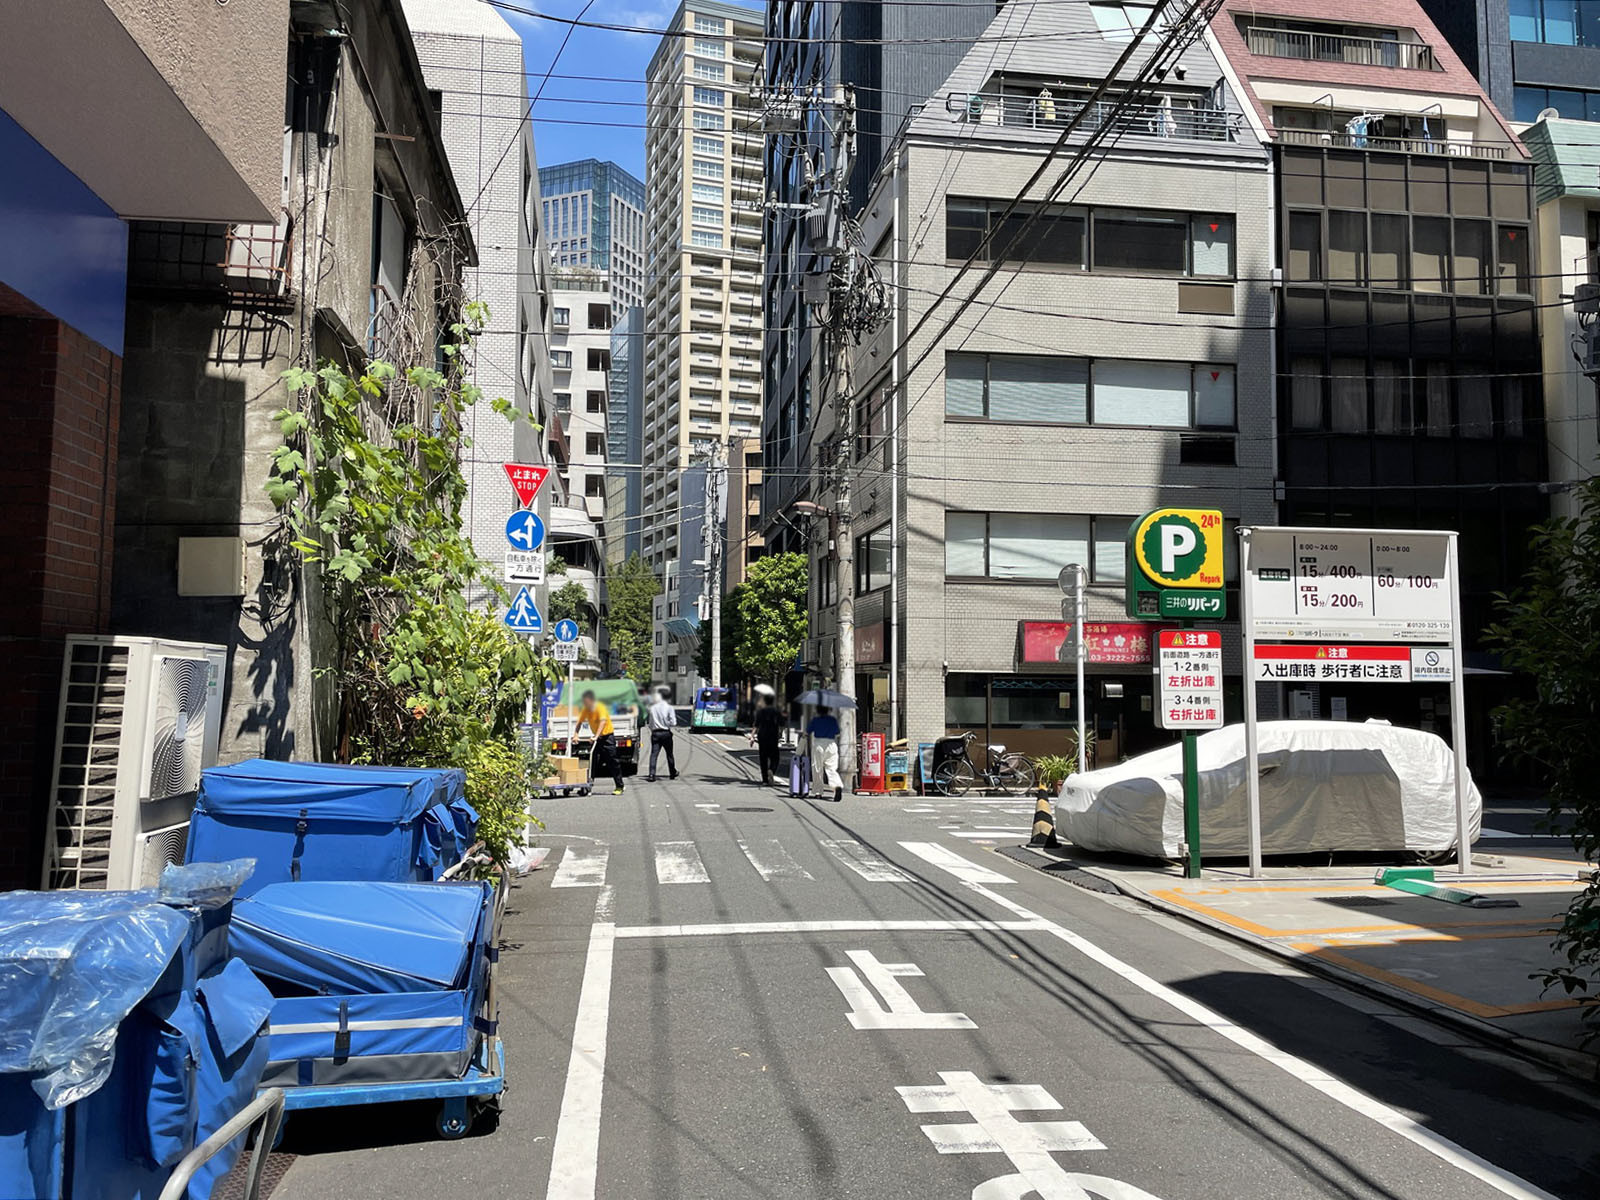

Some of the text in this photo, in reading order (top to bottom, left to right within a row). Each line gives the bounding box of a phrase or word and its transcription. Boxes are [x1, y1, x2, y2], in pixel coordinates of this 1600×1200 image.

[512, 469, 541, 480] 止まれ
[517, 481, 536, 490] STOP
[1201, 514, 1220, 528] 24h
[1161, 524, 1196, 572] P
[508, 564, 542, 573] 一方通行
[1200, 572, 1221, 584] Repark
[1166, 597, 1220, 611] 三井のリパーク
[1186, 634, 1208, 645] 注意
[1192, 651, 1219, 659] 一方通行
[1328, 648, 1348, 658] 注意
[1262, 663, 1402, 679] 入出庫時 歩行者に注意
[1168, 675, 1215, 687] 左折出庫
[1169, 709, 1216, 720] 右折出庫
